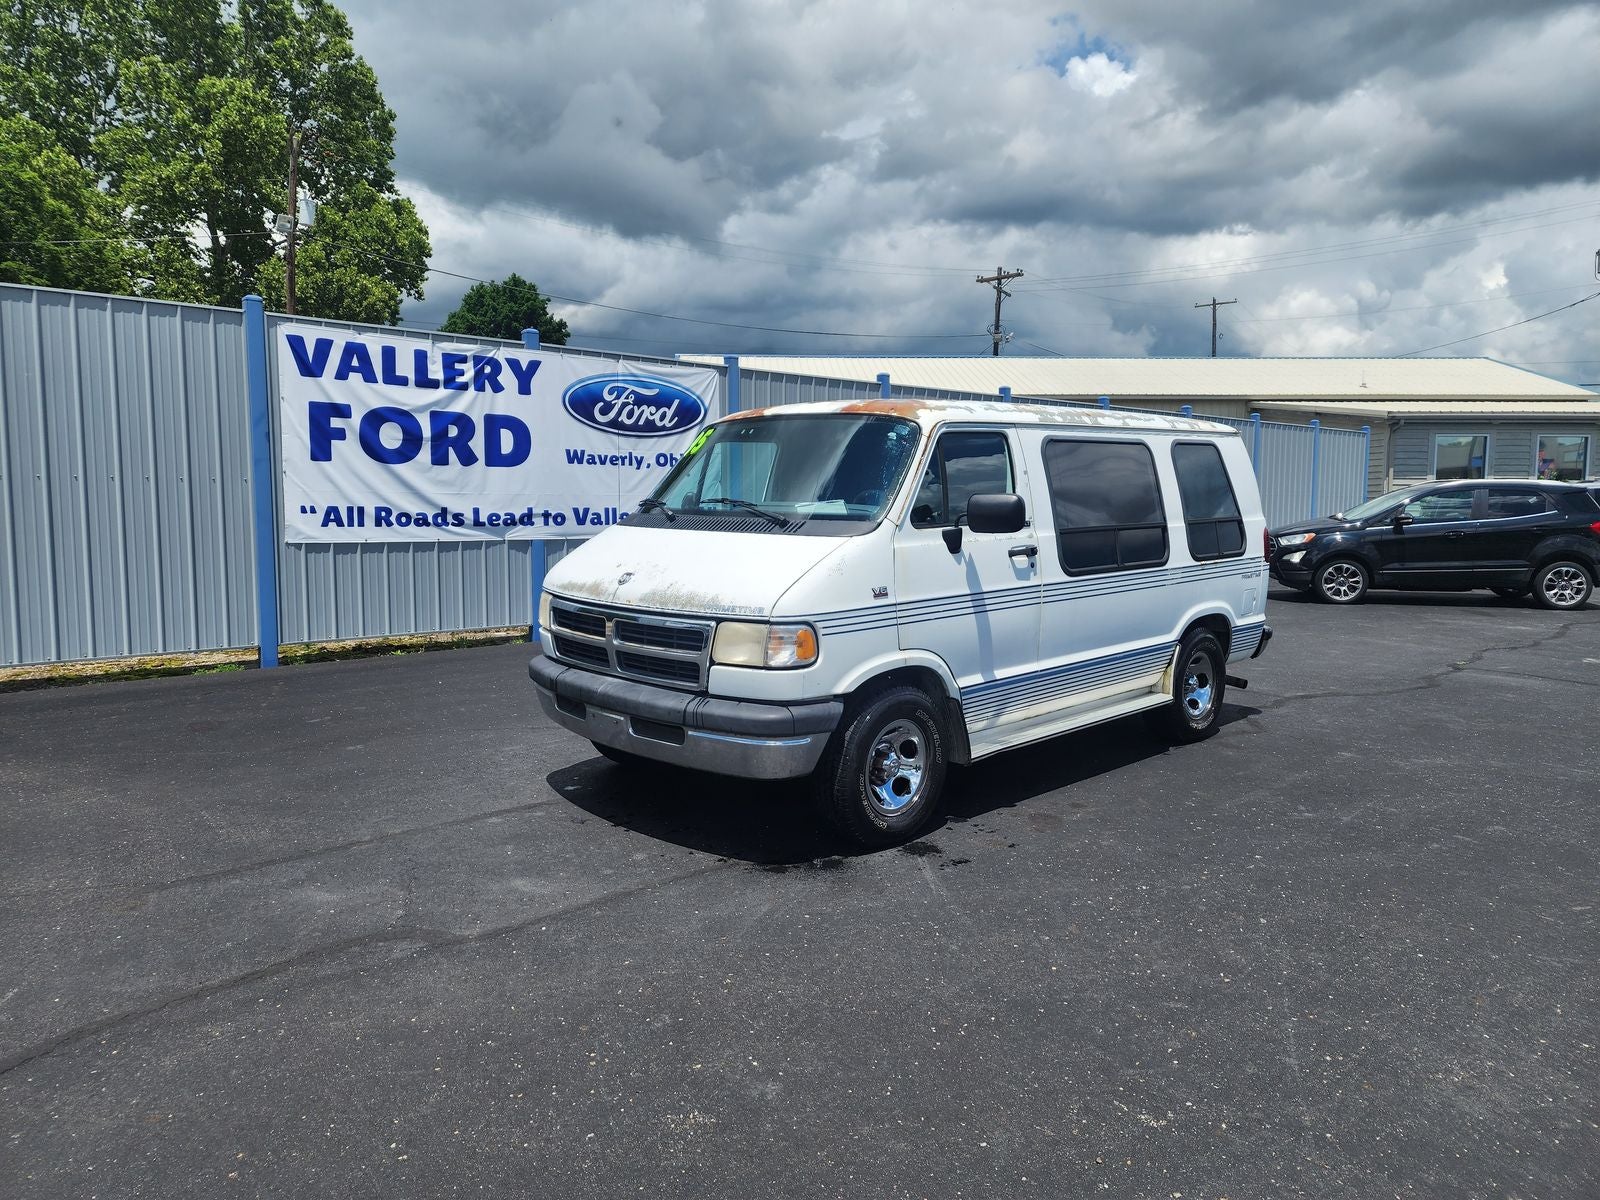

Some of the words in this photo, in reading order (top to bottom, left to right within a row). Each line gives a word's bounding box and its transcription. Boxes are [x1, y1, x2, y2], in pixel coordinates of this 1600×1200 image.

[285, 334, 542, 396] VALLERY
[593, 382, 679, 427] Ford
[308, 401, 532, 468] FORD
[565, 449, 651, 470] Waverly,
[655, 453, 685, 468] Oh
[374, 506, 465, 528] Roads
[472, 506, 535, 528] Lead
[541, 509, 567, 527] to
